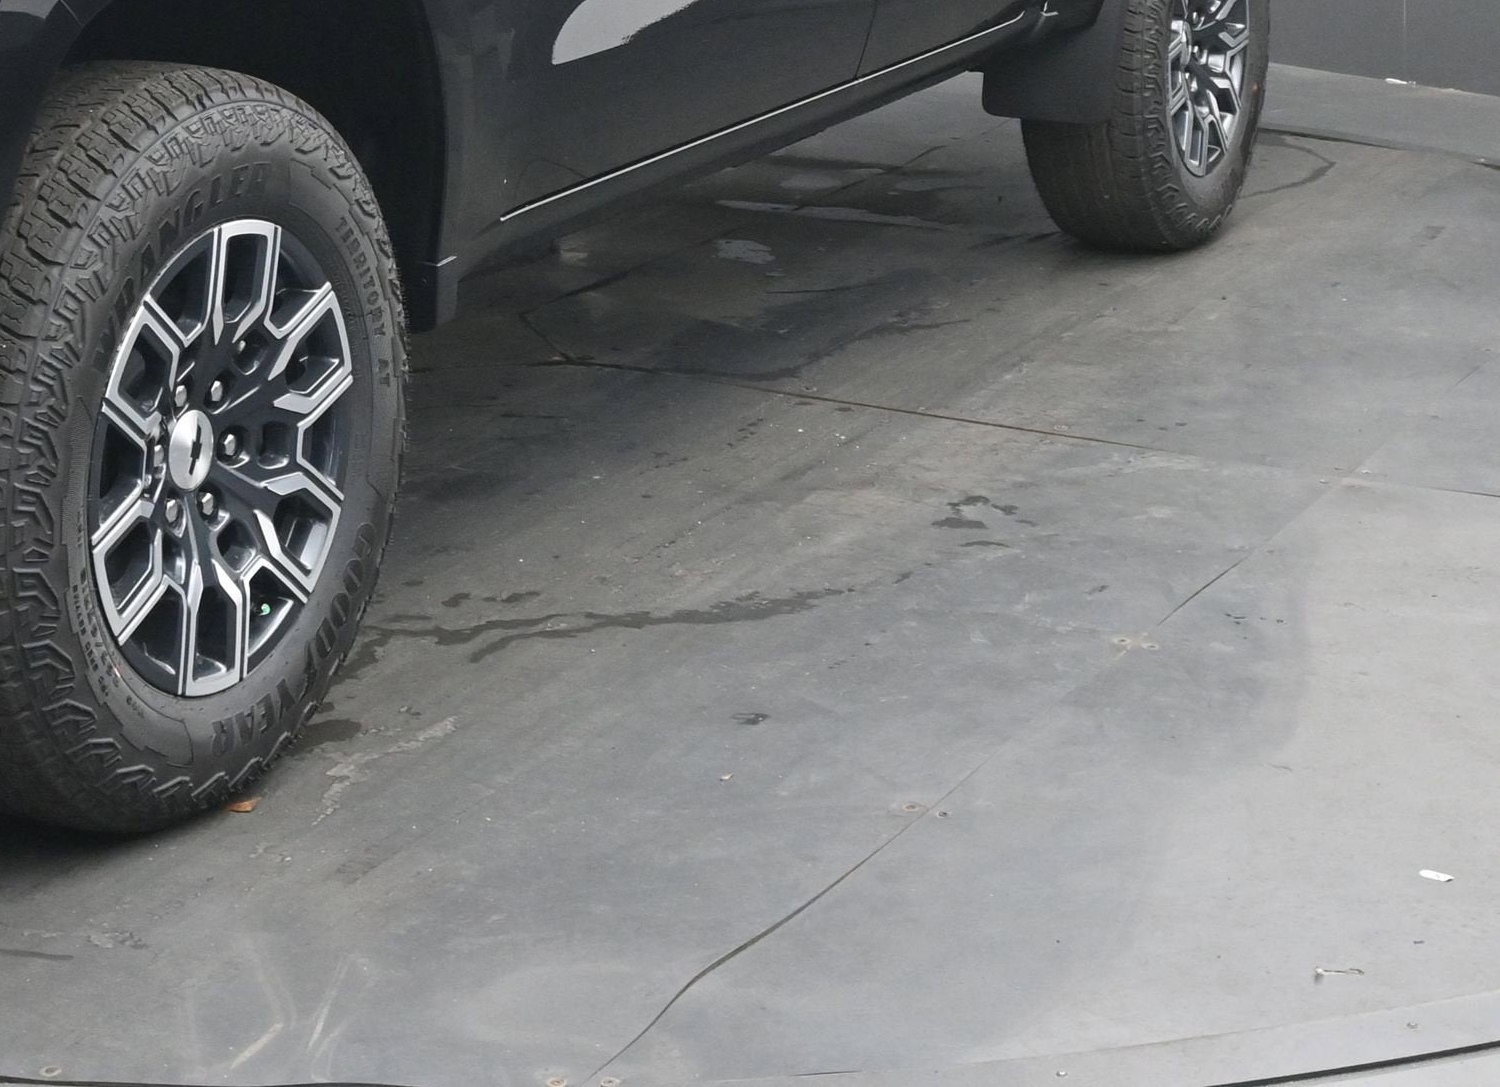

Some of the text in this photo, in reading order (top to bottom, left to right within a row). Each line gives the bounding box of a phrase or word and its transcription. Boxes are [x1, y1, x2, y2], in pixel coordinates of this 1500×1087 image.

[89, 159, 272, 373] WRANGLER
[334, 215, 386, 337] TERRITORY
[377, 358, 391, 388] AT
[211, 521, 377, 757] GOODYEAR
